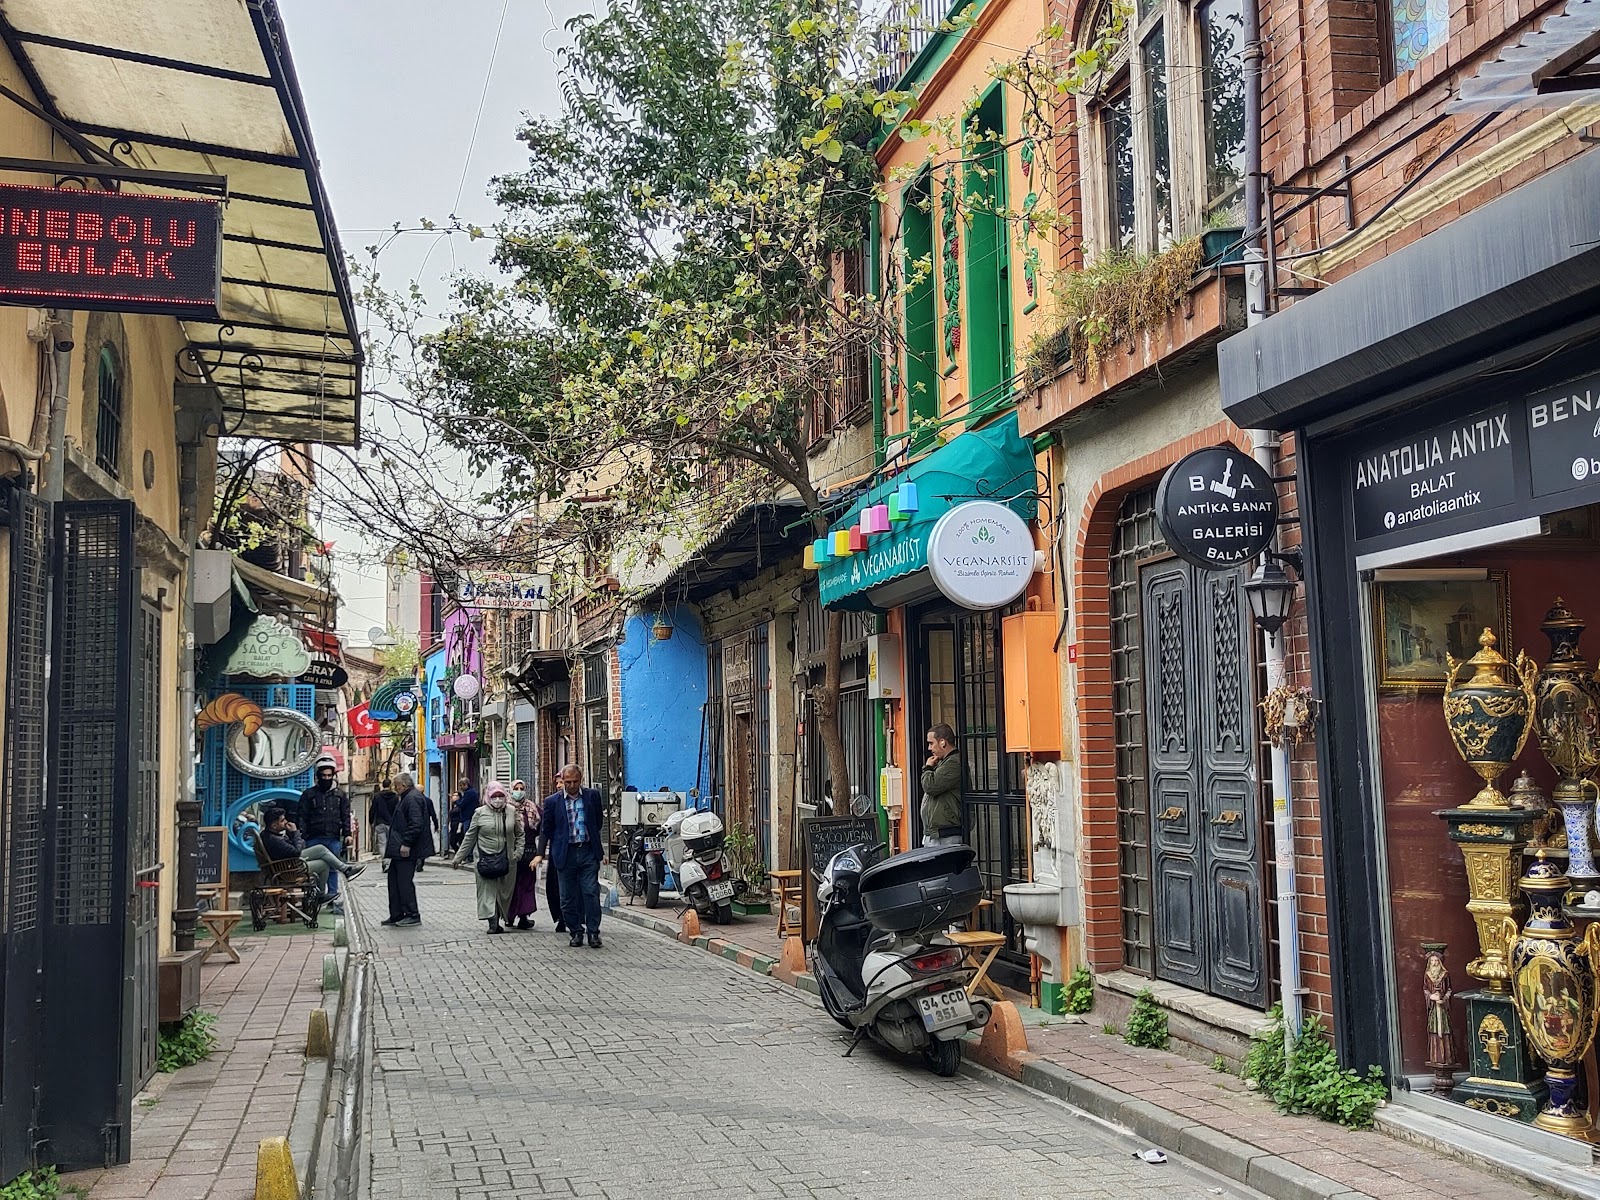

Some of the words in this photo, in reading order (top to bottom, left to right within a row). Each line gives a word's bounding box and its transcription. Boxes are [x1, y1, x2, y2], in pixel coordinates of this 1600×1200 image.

[18, 242, 176, 280] EMLAK
[1356, 436, 1444, 490] ANATOLIA
[1450, 413, 1510, 461] ANTIX
[1410, 472, 1456, 499] BALAT
[1178, 501, 1229, 516] ANTİKA
[1232, 501, 1273, 512] SANAT
[1397, 489, 1481, 525] anatoliaantix
[955, 521, 970, 538] 100%
[970, 518, 1011, 535] HOMEMADE
[1192, 521, 1263, 539] GALERİSİ
[862, 536, 920, 577] VEGANARSİST
[943, 555, 1028, 567] VEGANARSİST
[1206, 547, 1250, 560] BALAT
[242, 644, 280, 655] SAGO
[843, 830, 873, 843] VEGAN
[922, 997, 939, 1011] 34
[941, 990, 964, 1006] CCD
[935, 1006, 958, 1022] 351
